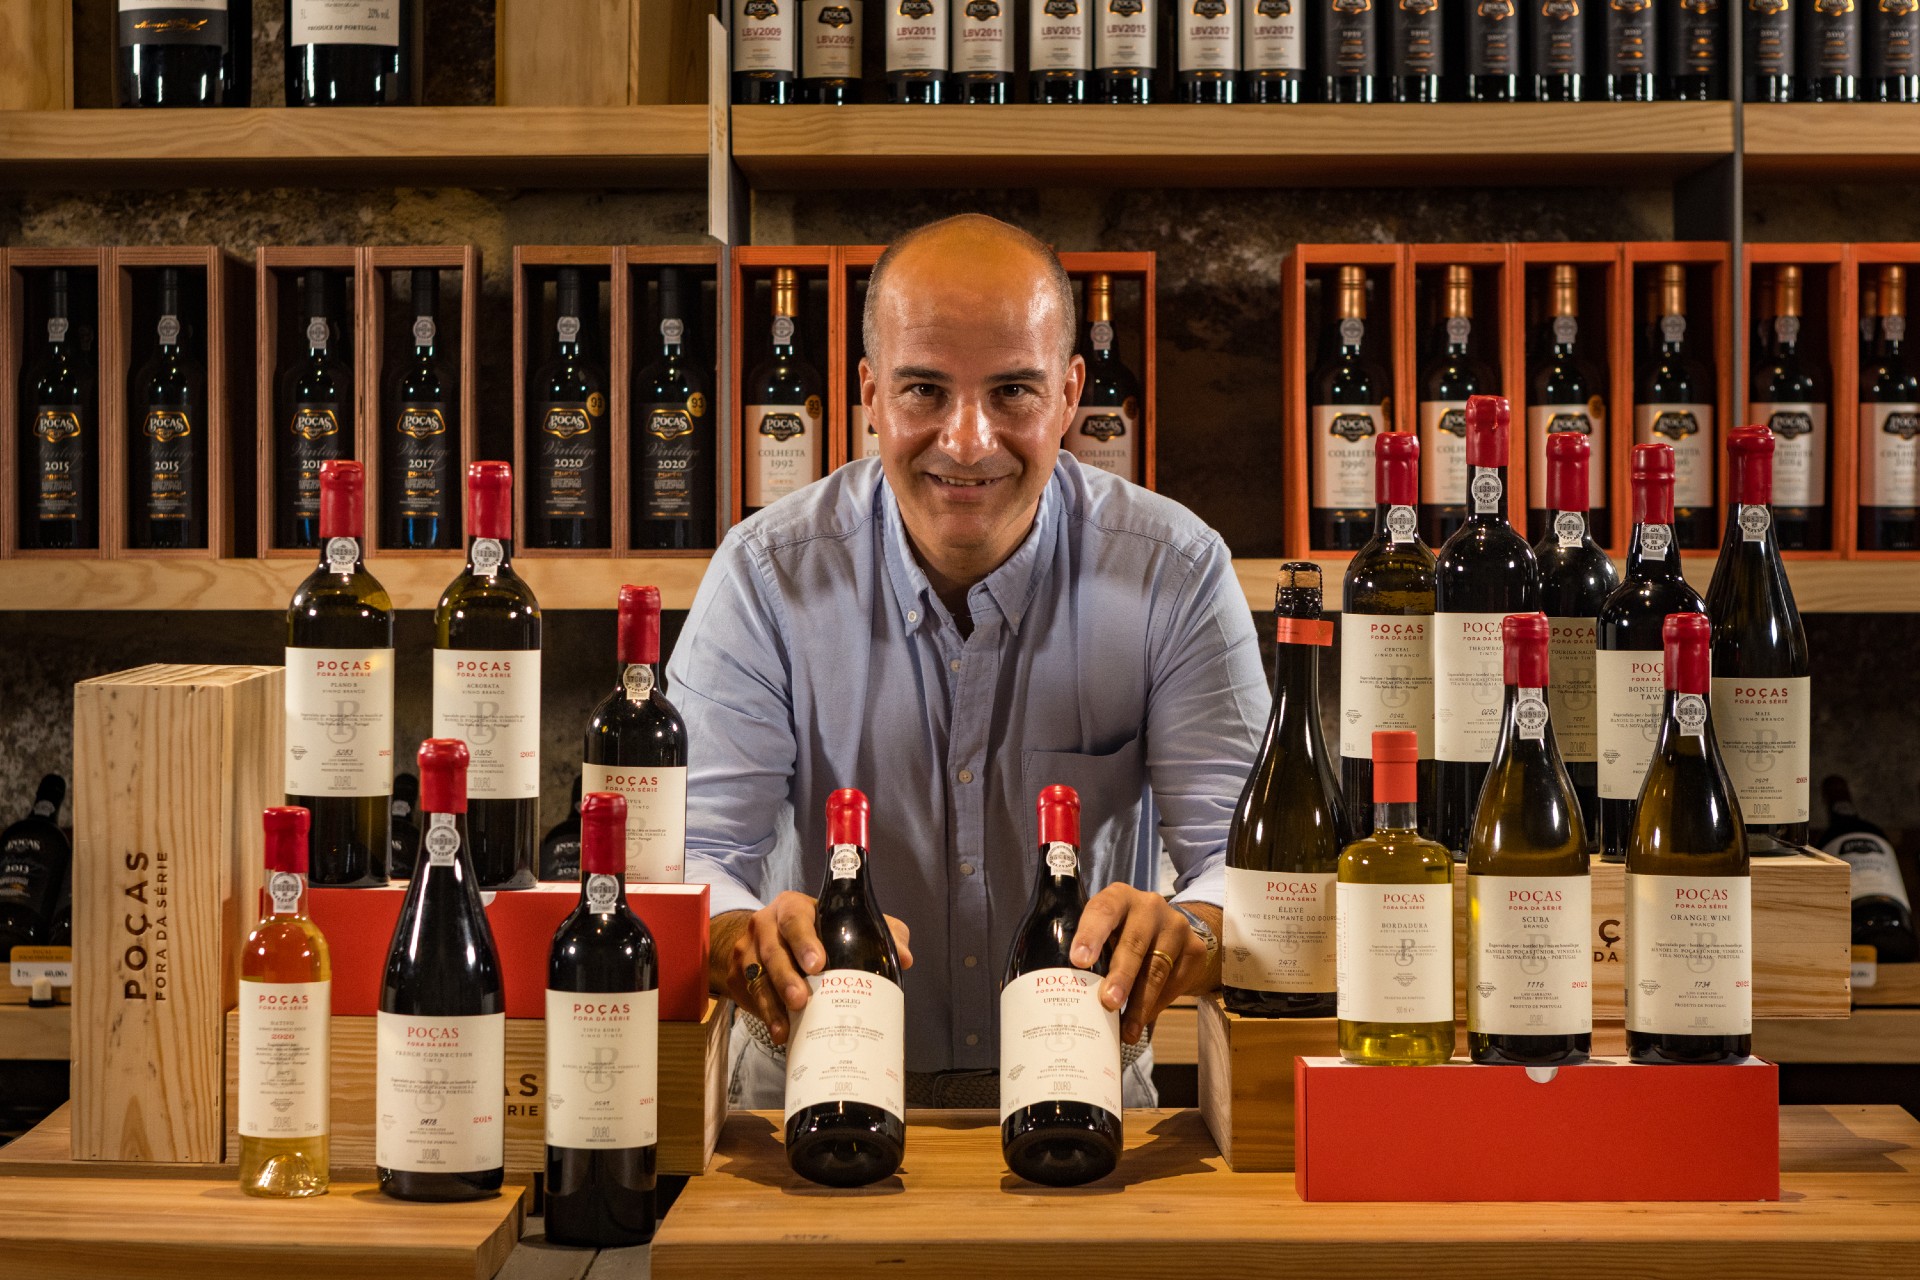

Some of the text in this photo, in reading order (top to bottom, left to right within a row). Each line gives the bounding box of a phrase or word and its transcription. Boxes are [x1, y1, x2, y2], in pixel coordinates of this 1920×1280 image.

[742, 28, 781, 36] LBV2009
[897, 26, 936, 36] LBV2011
[963, 28, 1002, 38] LBV2011
[1042, 26, 1081, 36] LBV2015
[1107, 24, 1146, 34] LBV2015
[1190, 26, 1230, 36] LBV2017
[1254, 26, 1294, 36] LBV2017
[692, 398, 704, 408] 93
[548, 416, 584, 429] POÇAS
[651, 416, 688, 430] POÇAS
[759, 449, 806, 457] COLHEITA
[1079, 449, 1127, 458] COLHEITA
[45, 462, 70, 472] 2015
[154, 462, 179, 472] 2015
[409, 458, 434, 470] 2017
[554, 458, 584, 468] 2020
[658, 460, 687, 468] 2020
[770, 460, 794, 468] 1992
[1340, 459, 1364, 470] 1996
[1371, 624, 1424, 634] POÇAS
[1463, 622, 1503, 635] POÇA
[1552, 628, 1596, 638] POÇA
[317, 661, 371, 672] POÇAS
[457, 662, 511, 672] POÇAS
[1632, 663, 1664, 676] POÇ
[1736, 688, 1788, 699] POÇAS
[606, 775, 659, 786] POÇAS
[5, 864, 30, 873] 2013
[1267, 881, 1317, 895] POÇAS
[1383, 894, 1425, 905] POÇAS
[1509, 890, 1562, 904] POÇAS
[1676, 889, 1728, 903] POÇAS
[125, 852, 152, 1000] POÇAS
[154, 852, 168, 1000] FORA DA SÉRIE
[1594, 952, 1618, 962] DA
[821, 977, 873, 989] POÇAS
[1036, 975, 1088, 987] POÇAS
[259, 995, 309, 1005] POÇAS
[574, 1004, 630, 1015] POÇAS
[408, 1027, 459, 1041] POÇAS
[1054, 1081, 1071, 1091] DOURO
